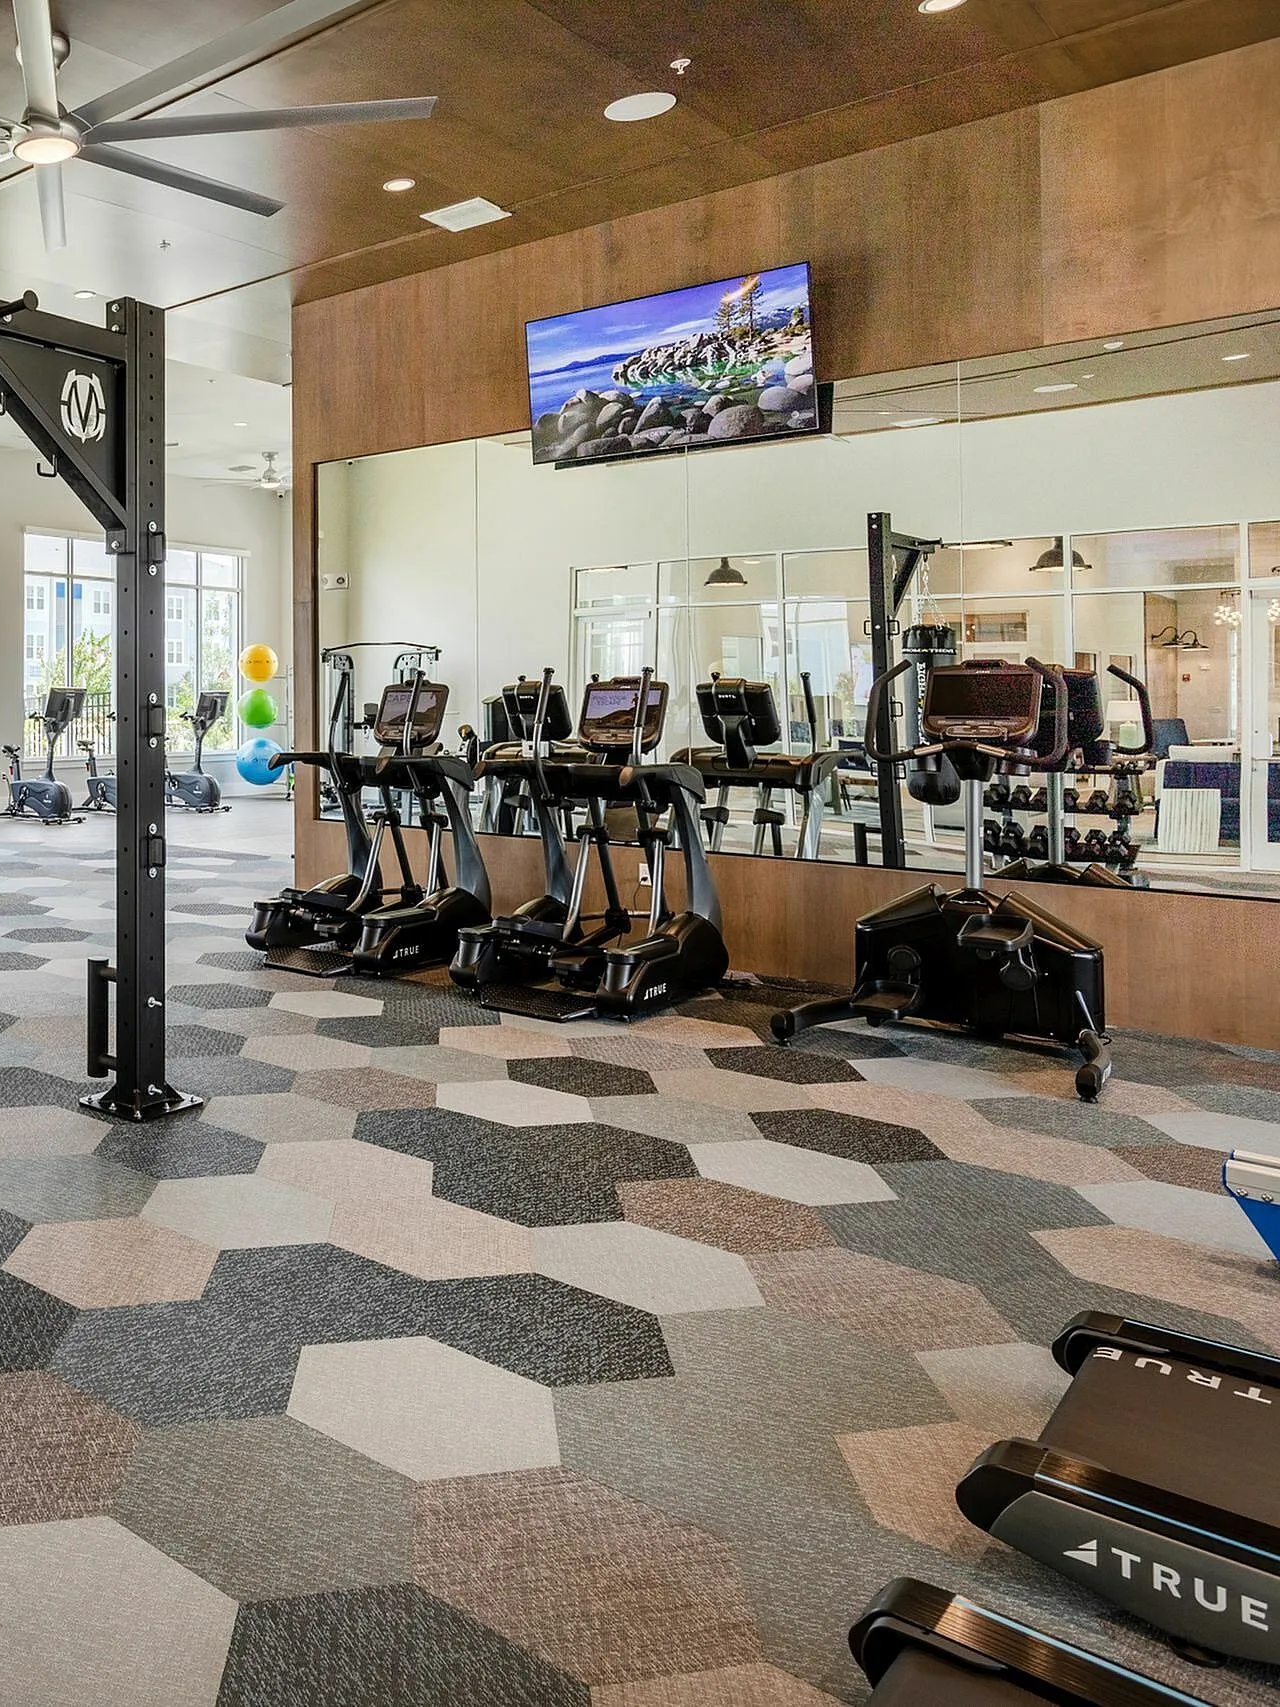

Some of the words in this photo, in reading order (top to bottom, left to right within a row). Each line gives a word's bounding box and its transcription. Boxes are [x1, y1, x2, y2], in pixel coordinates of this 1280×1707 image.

[399, 944, 420, 958] TRUE
[648, 983, 668, 999] TRUE
[1092, 1346, 1272, 1405] TRUE
[1111, 1547, 1270, 1632] TRUE
